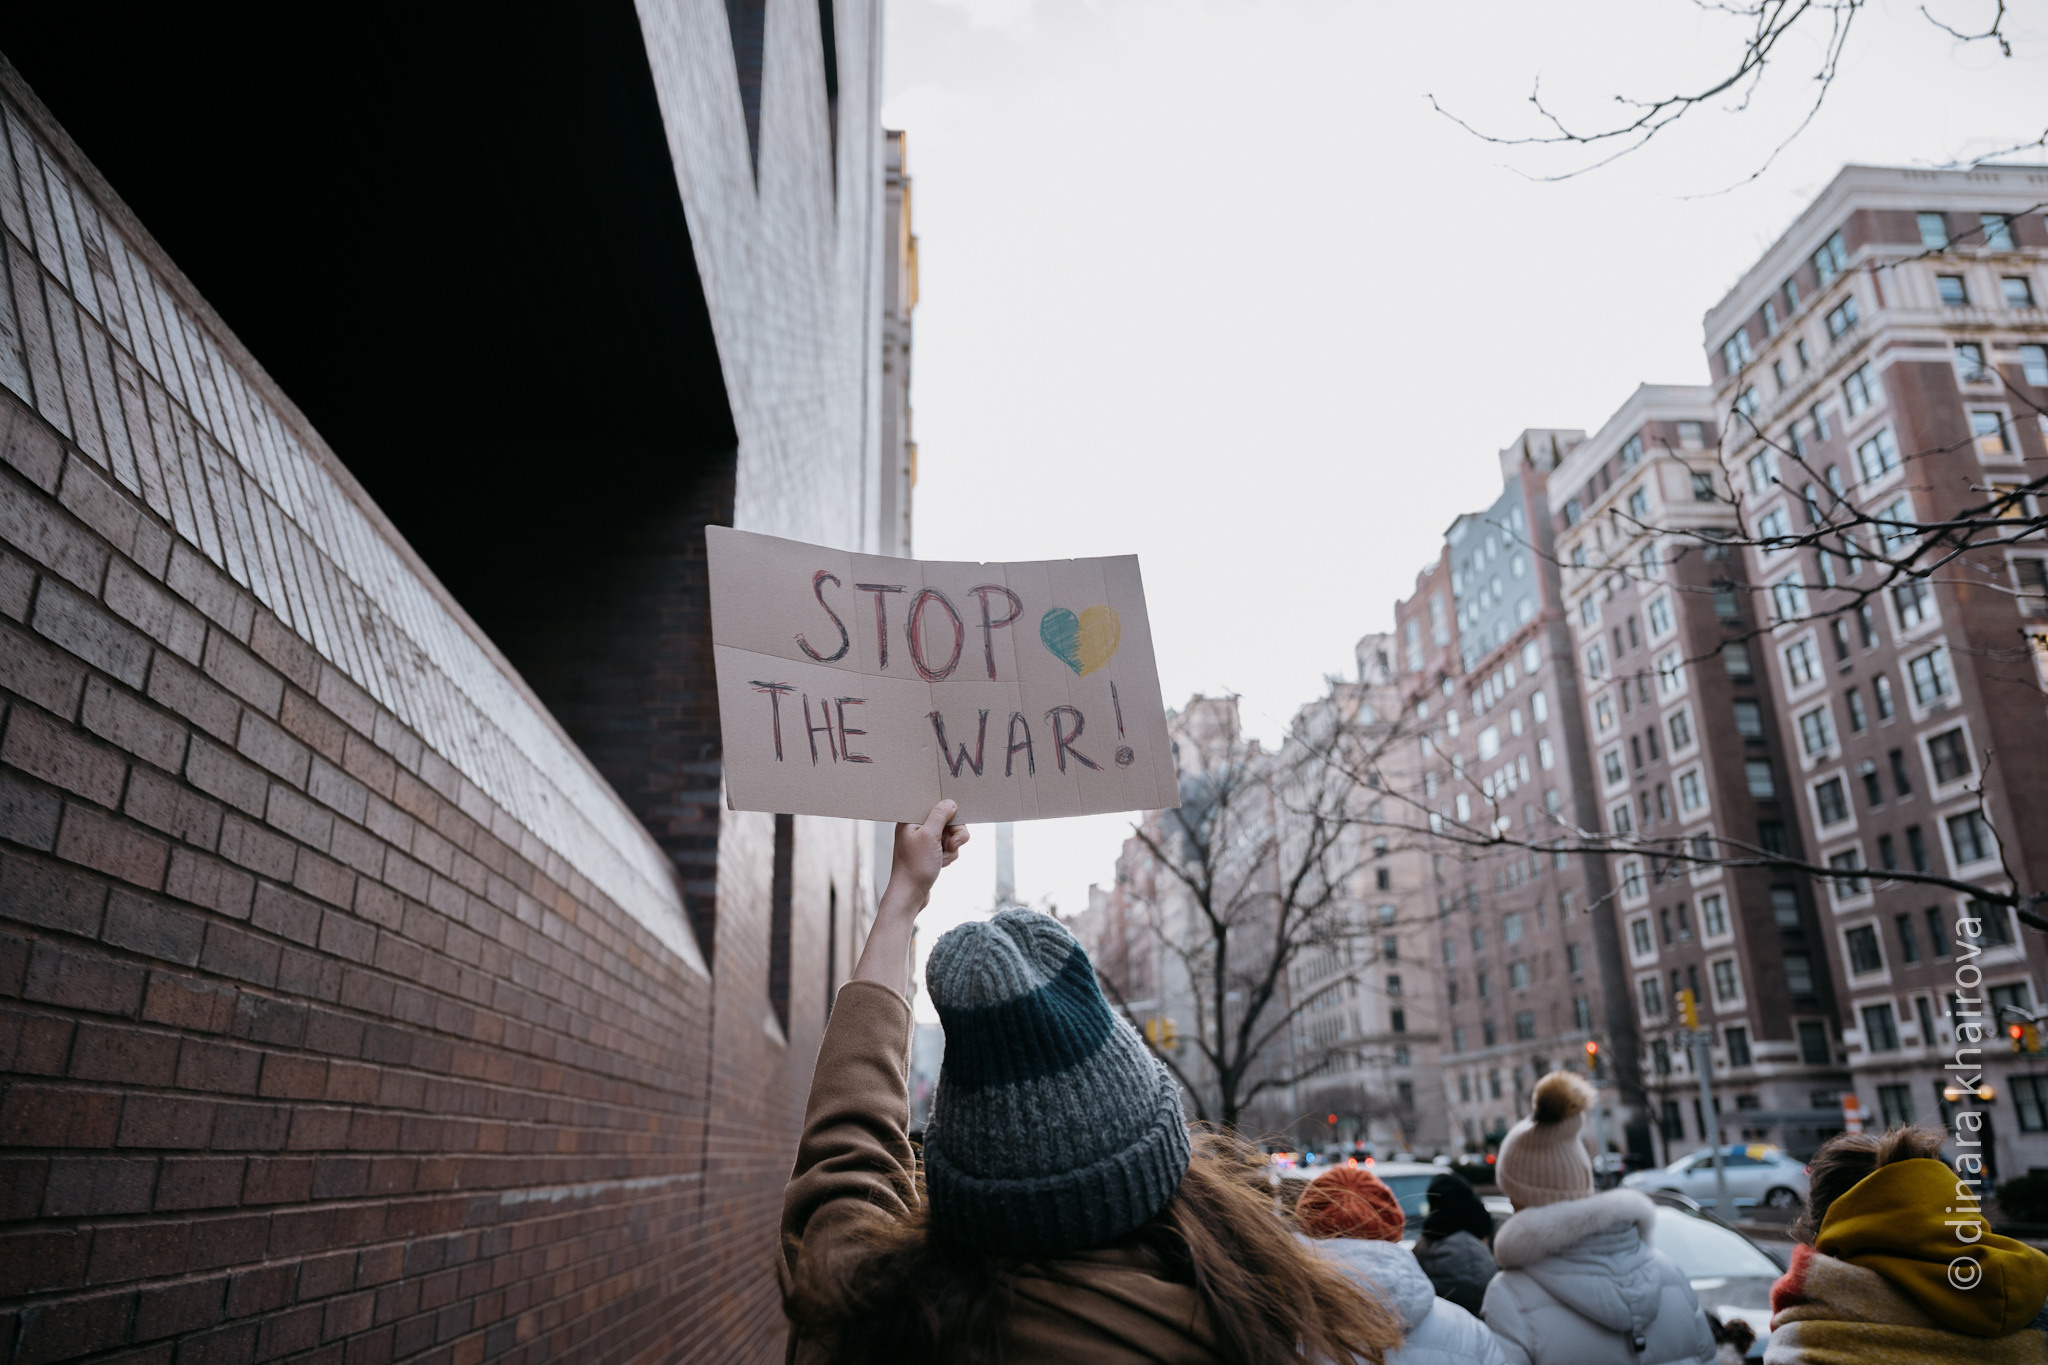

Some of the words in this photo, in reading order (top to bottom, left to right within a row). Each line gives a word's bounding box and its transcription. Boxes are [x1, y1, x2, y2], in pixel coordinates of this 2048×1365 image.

[793, 569, 1025, 683] STOP
[747, 679, 874, 768] THE
[925, 680, 1136, 778] WAR!
